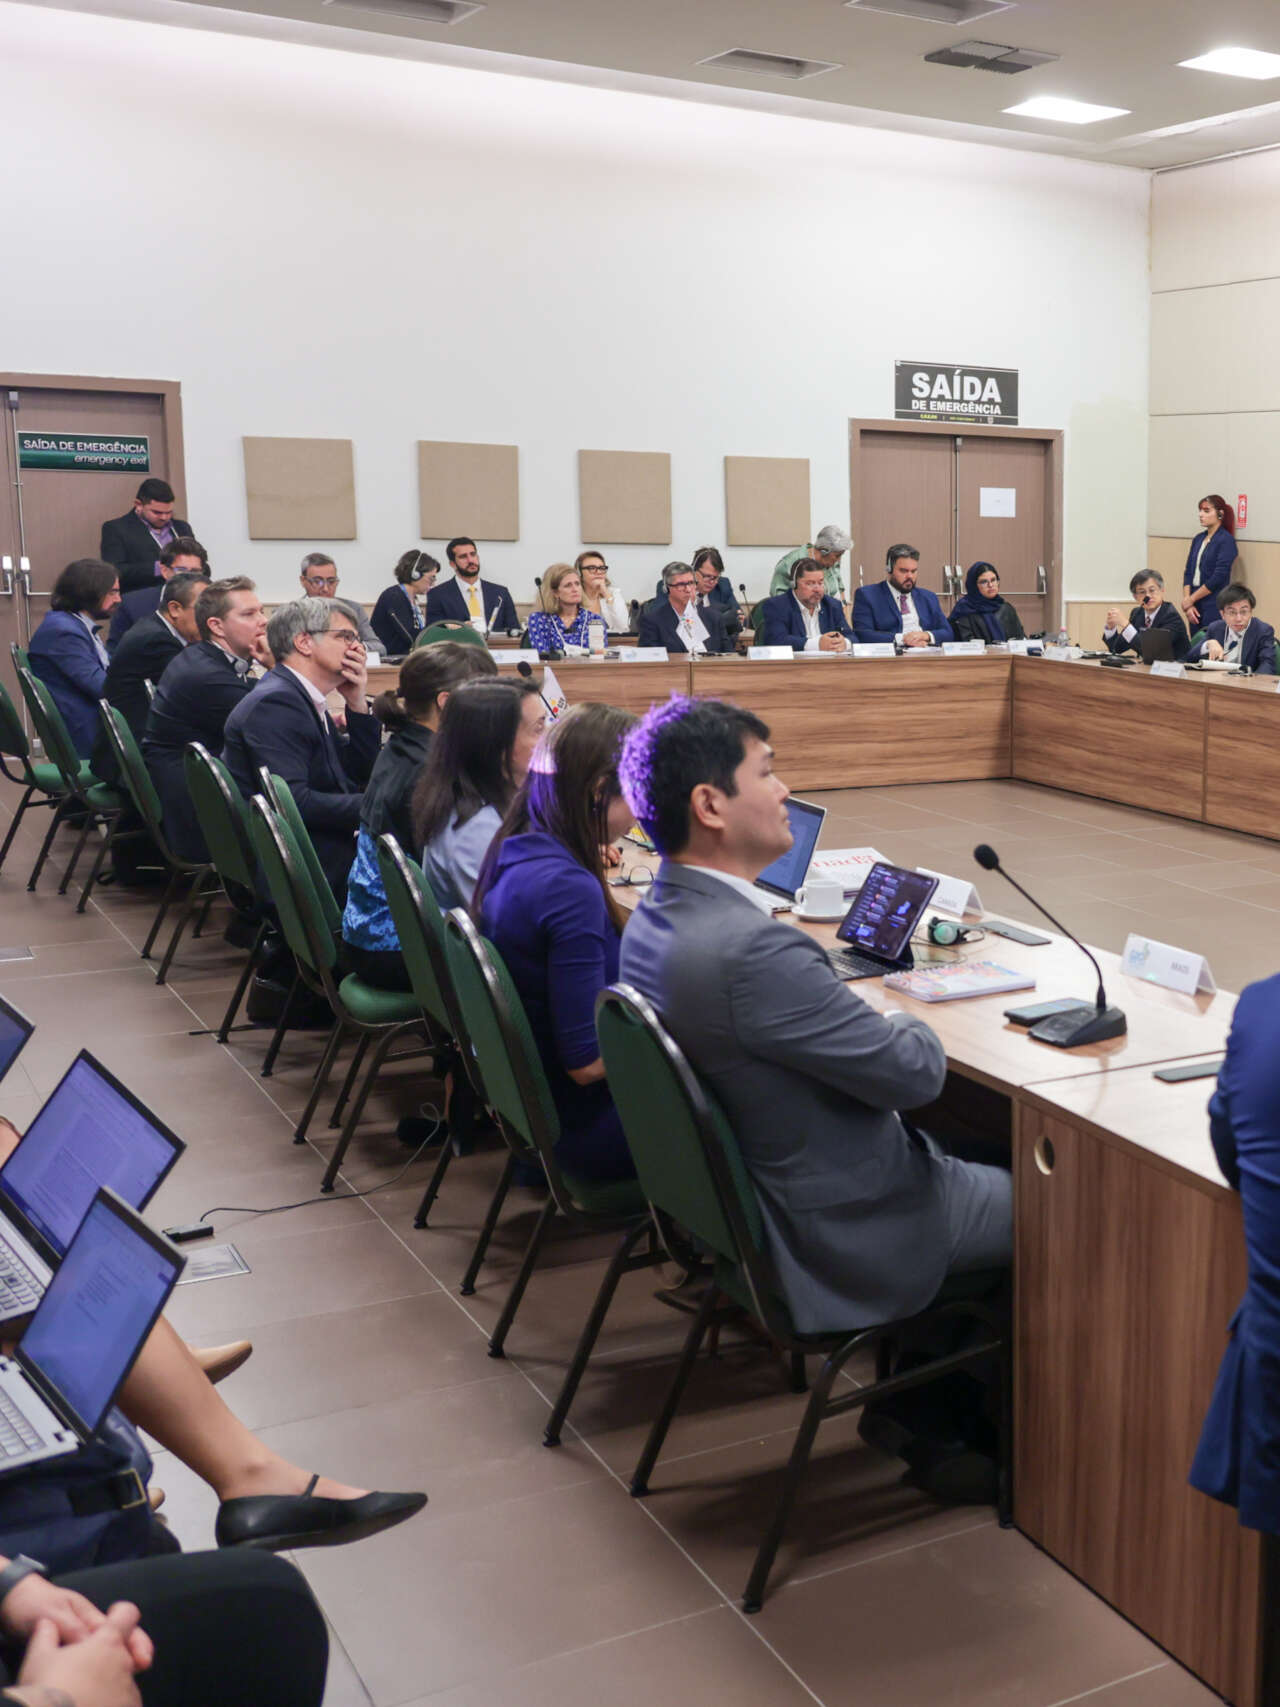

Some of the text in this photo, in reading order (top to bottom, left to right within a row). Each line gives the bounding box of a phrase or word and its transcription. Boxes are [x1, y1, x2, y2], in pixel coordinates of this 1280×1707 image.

[912, 369, 1001, 402] SAÍDA
[911, 400, 1001, 415] DE EMERGÊNCIA
[24, 438, 146, 453] SAÍDA DE EMERGÊNCIA
[74, 455, 147, 465] emergency exit
